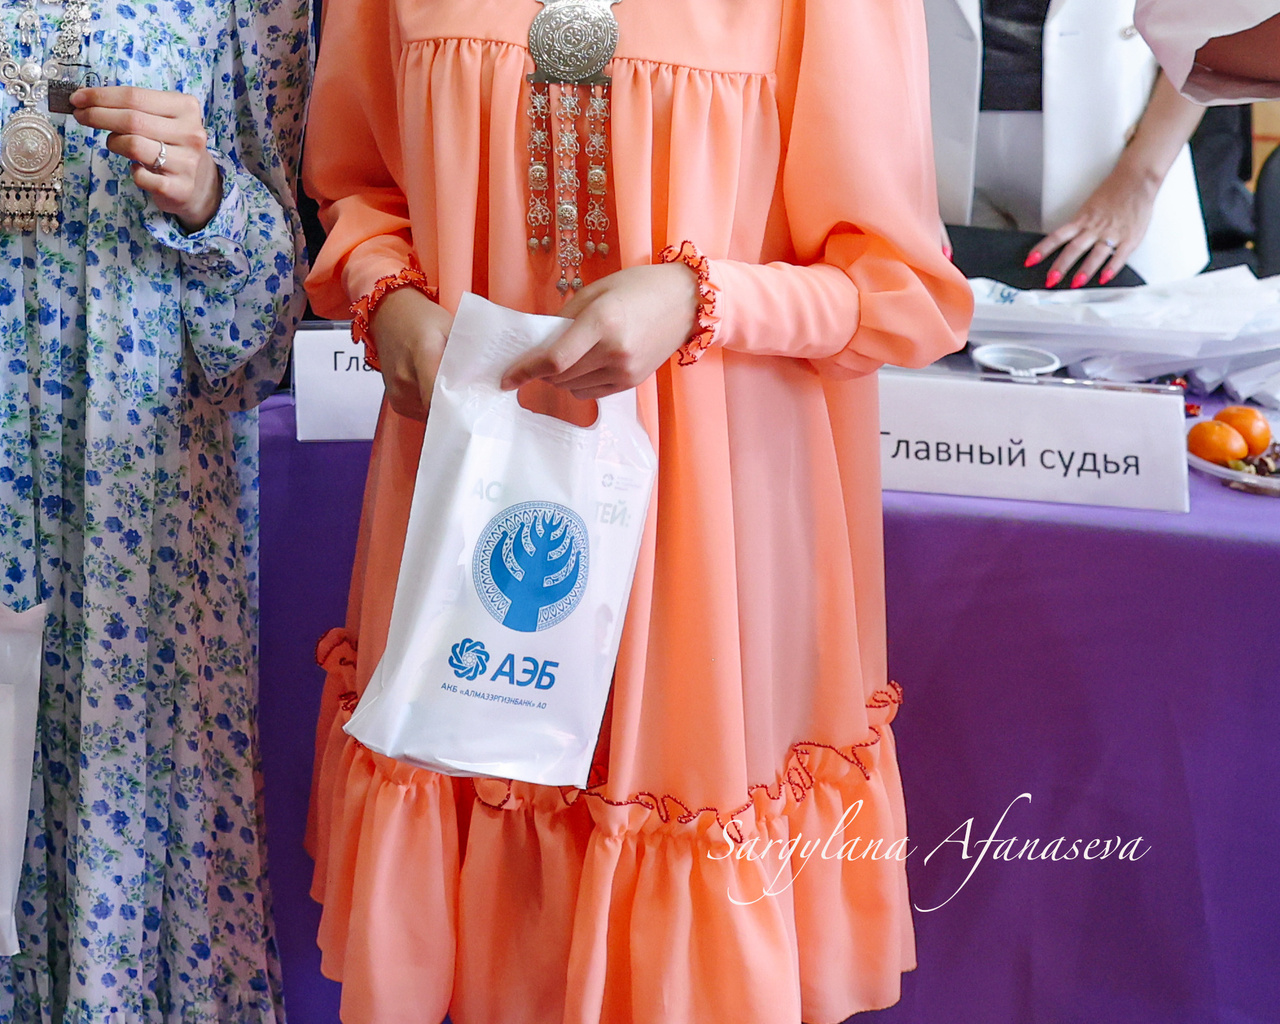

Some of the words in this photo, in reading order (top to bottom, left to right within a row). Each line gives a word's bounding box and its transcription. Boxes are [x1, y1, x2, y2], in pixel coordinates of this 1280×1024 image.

[1040, 448, 1140, 478] судья
[490, 653, 560, 691] АЭБ
[440, 682, 458, 693] АКБ
[536, 701, 547, 710] АО
